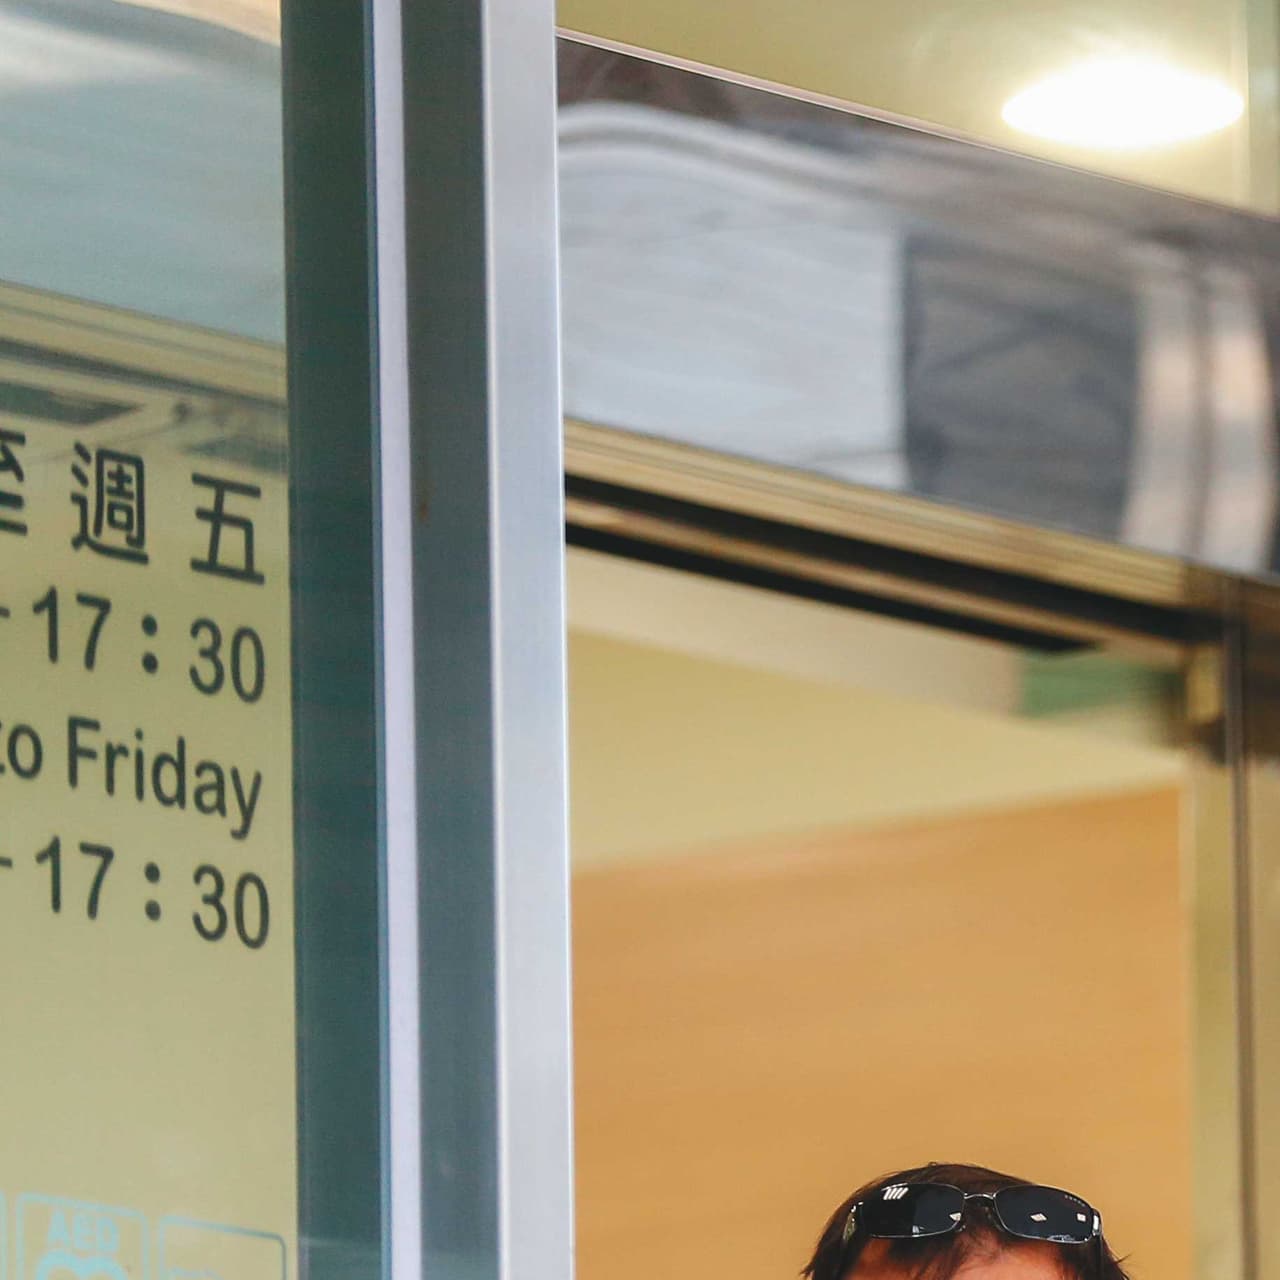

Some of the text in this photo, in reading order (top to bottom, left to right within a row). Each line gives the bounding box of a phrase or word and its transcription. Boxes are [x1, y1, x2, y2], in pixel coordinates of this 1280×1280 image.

[0, 715, 262, 840] o Friday
[47, 1211, 120, 1253] AED
